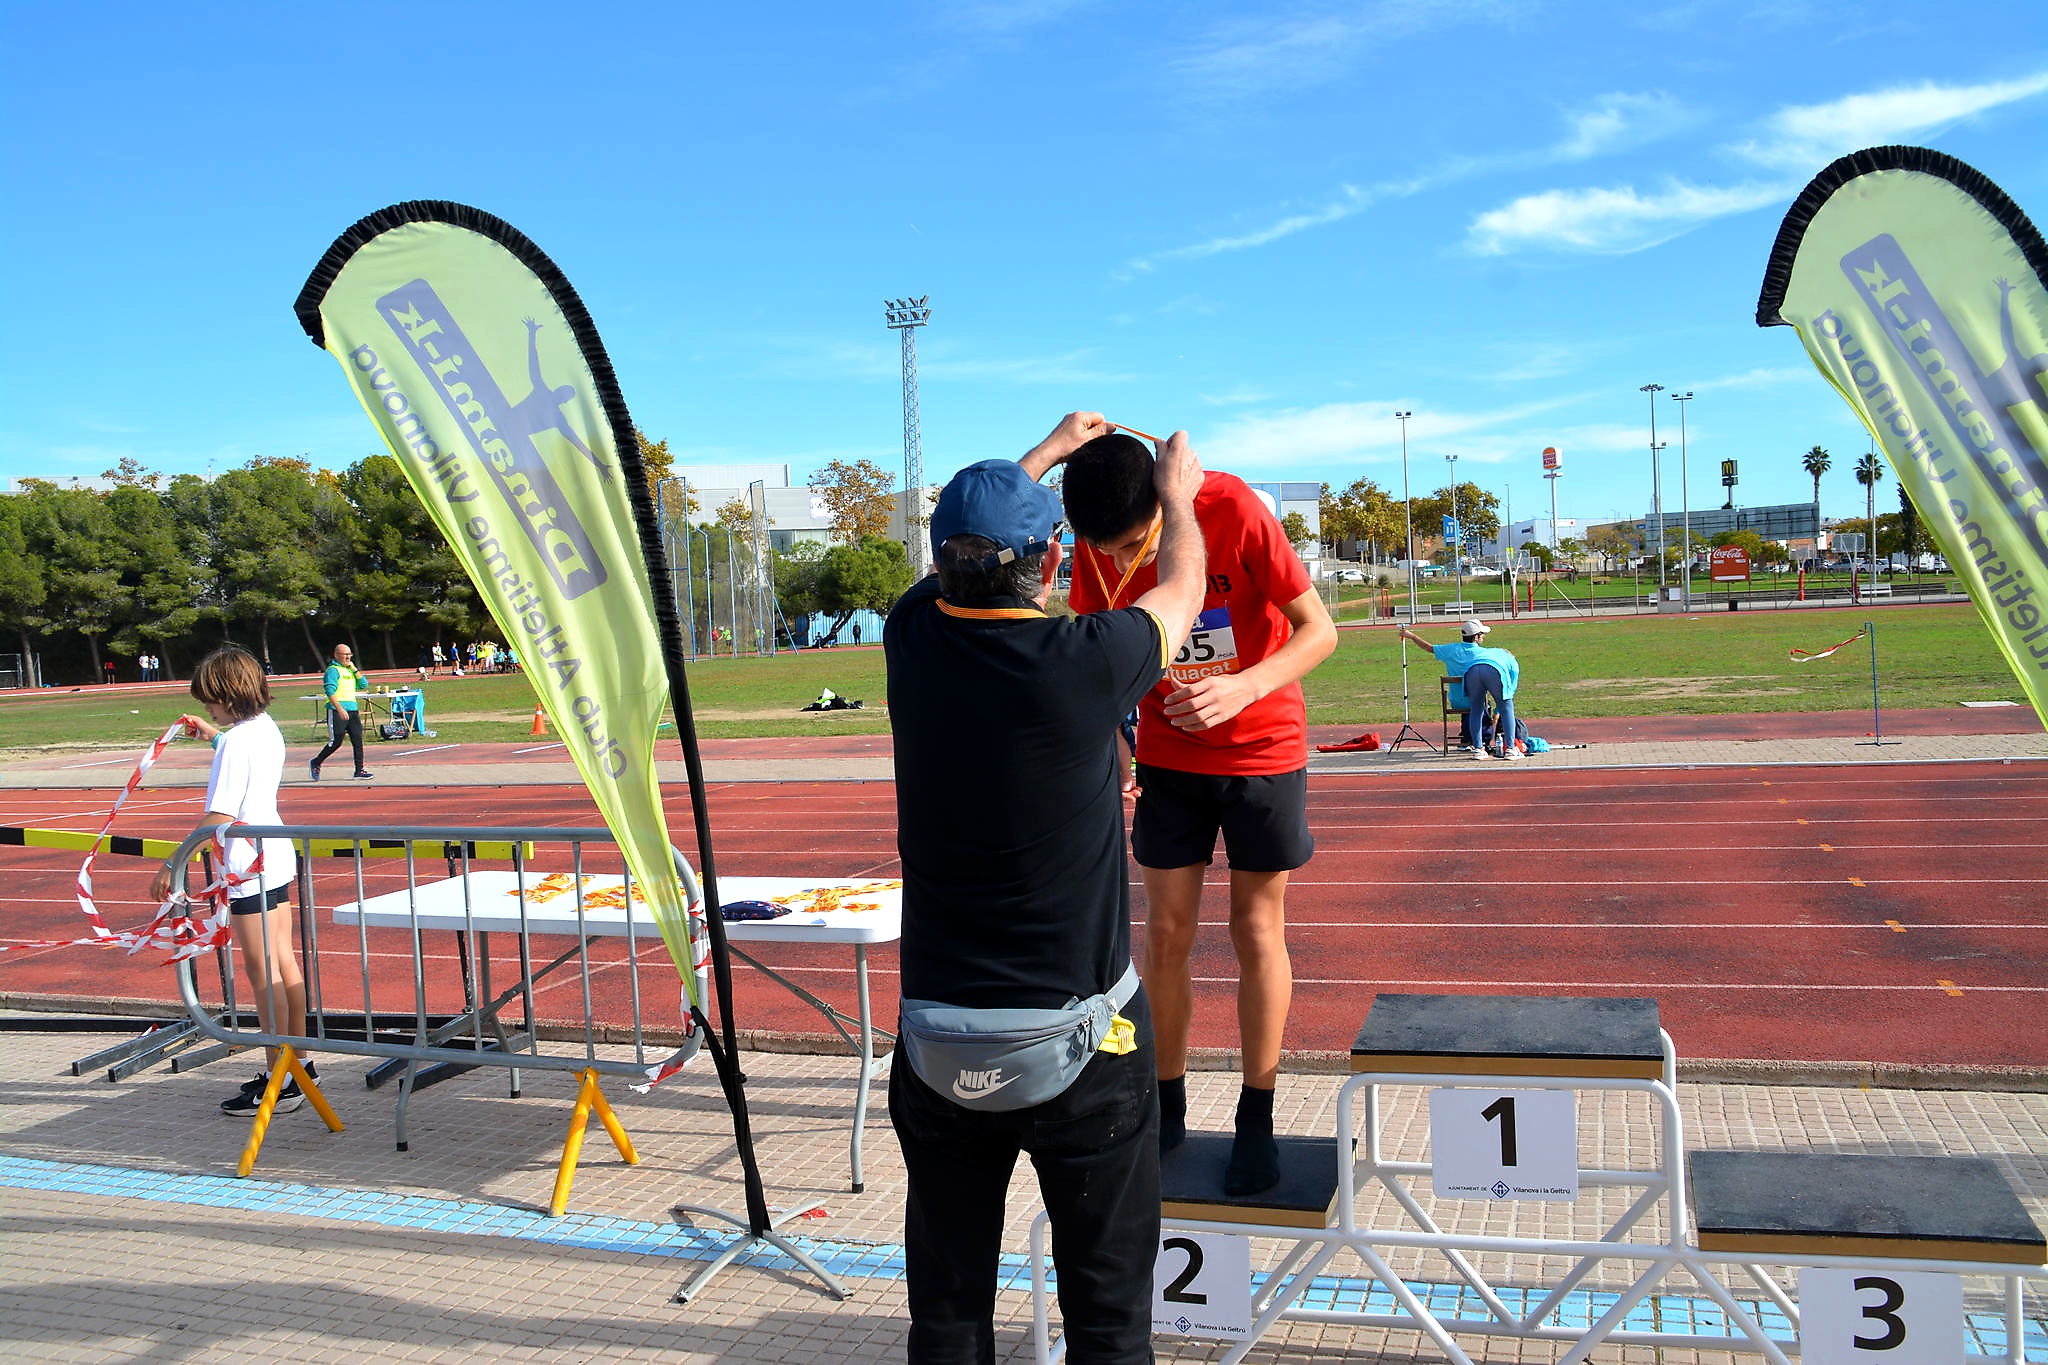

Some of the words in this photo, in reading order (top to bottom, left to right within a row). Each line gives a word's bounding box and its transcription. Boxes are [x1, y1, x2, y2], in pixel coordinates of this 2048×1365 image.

[960, 1068, 1002, 1089] NIKE
[1481, 1097, 1517, 1167] 1
[1513, 1186, 1539, 1194] Vilanova
[1162, 1237, 1208, 1306] 2
[1194, 1323, 1218, 1331] Vilanova
[1853, 1276, 1906, 1351] 3
